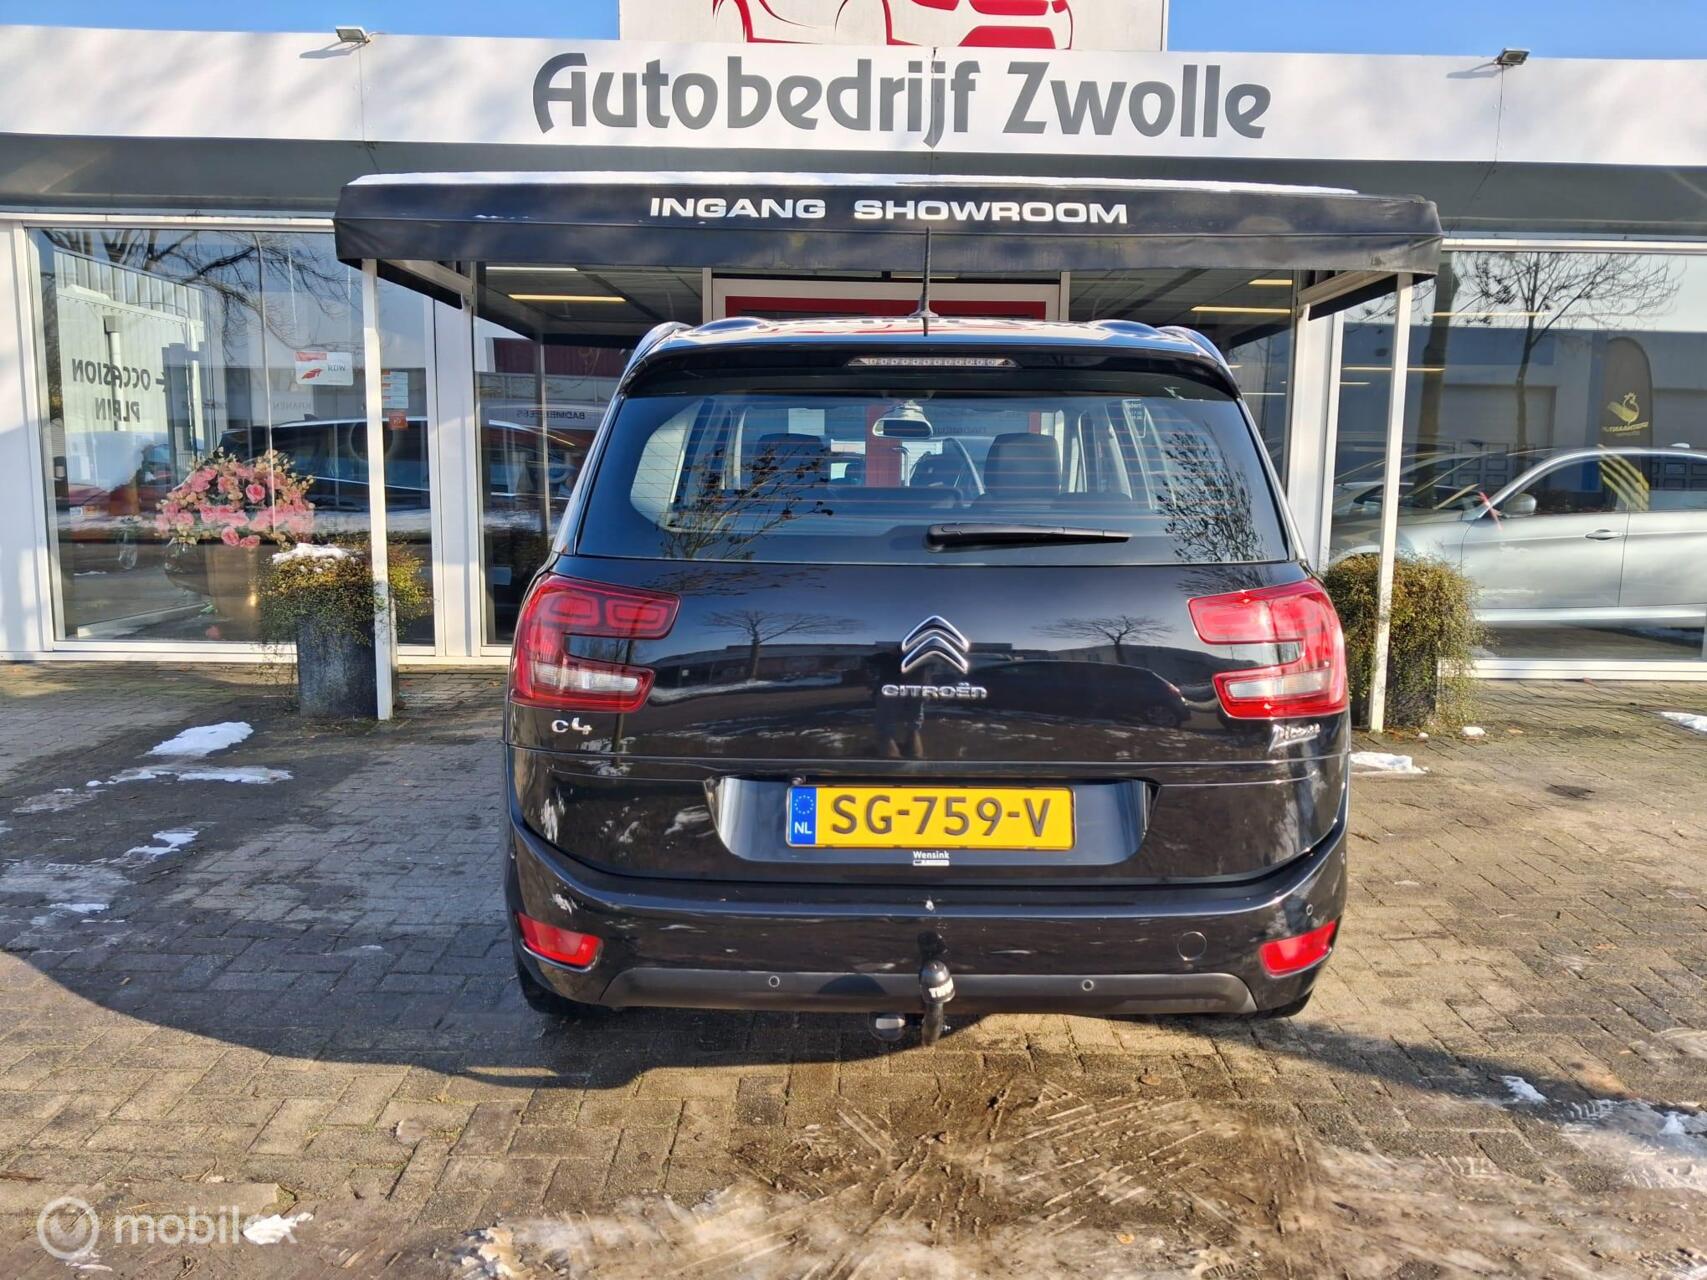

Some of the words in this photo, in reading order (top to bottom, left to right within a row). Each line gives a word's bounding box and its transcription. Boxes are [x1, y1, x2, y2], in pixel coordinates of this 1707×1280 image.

[533, 52, 980, 149] Autobedrijf
[1002, 61, 1272, 139] Zwolle
[650, 197, 827, 219] INGANG
[853, 200, 1128, 224] SHOWROOM
[551, 717, 592, 735] C4
[831, 794, 1051, 838] SG-759-V
[794, 822, 813, 835] NL
[912, 850, 950, 860] Wensink
